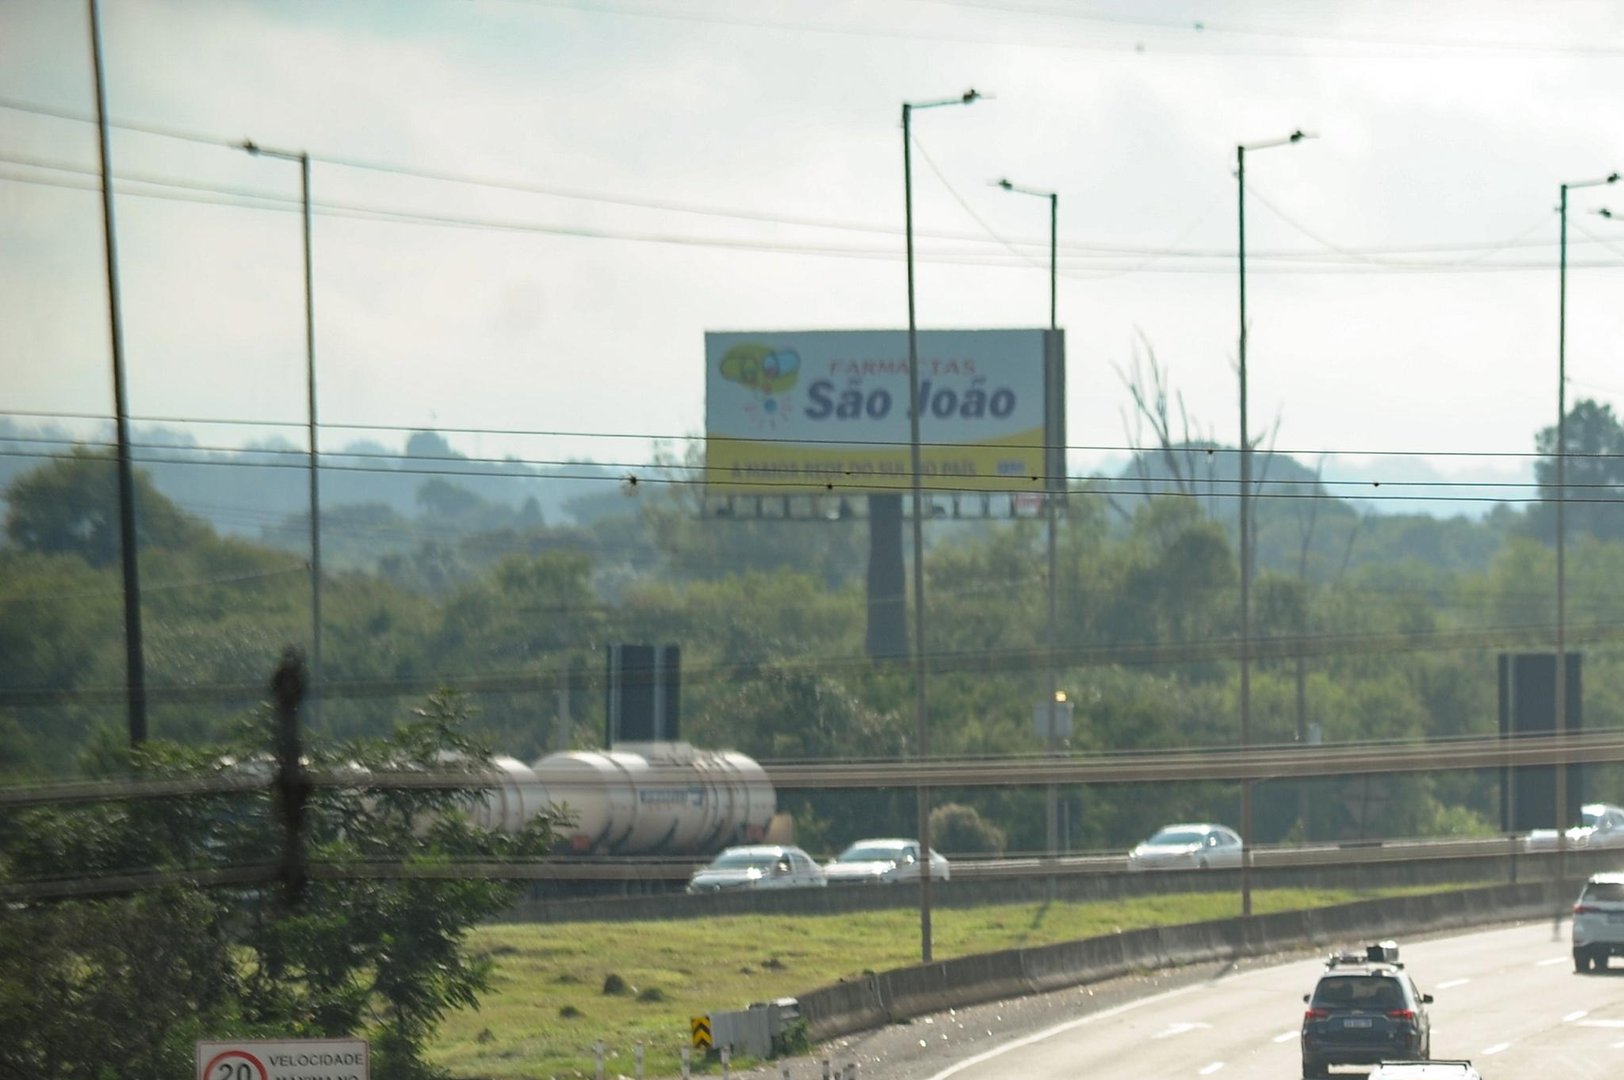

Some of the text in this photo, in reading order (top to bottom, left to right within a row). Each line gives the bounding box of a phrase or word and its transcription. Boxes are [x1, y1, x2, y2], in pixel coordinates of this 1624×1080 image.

[804, 375, 1017, 421] São João
[268, 1053, 364, 1067] VELOCIDADE
